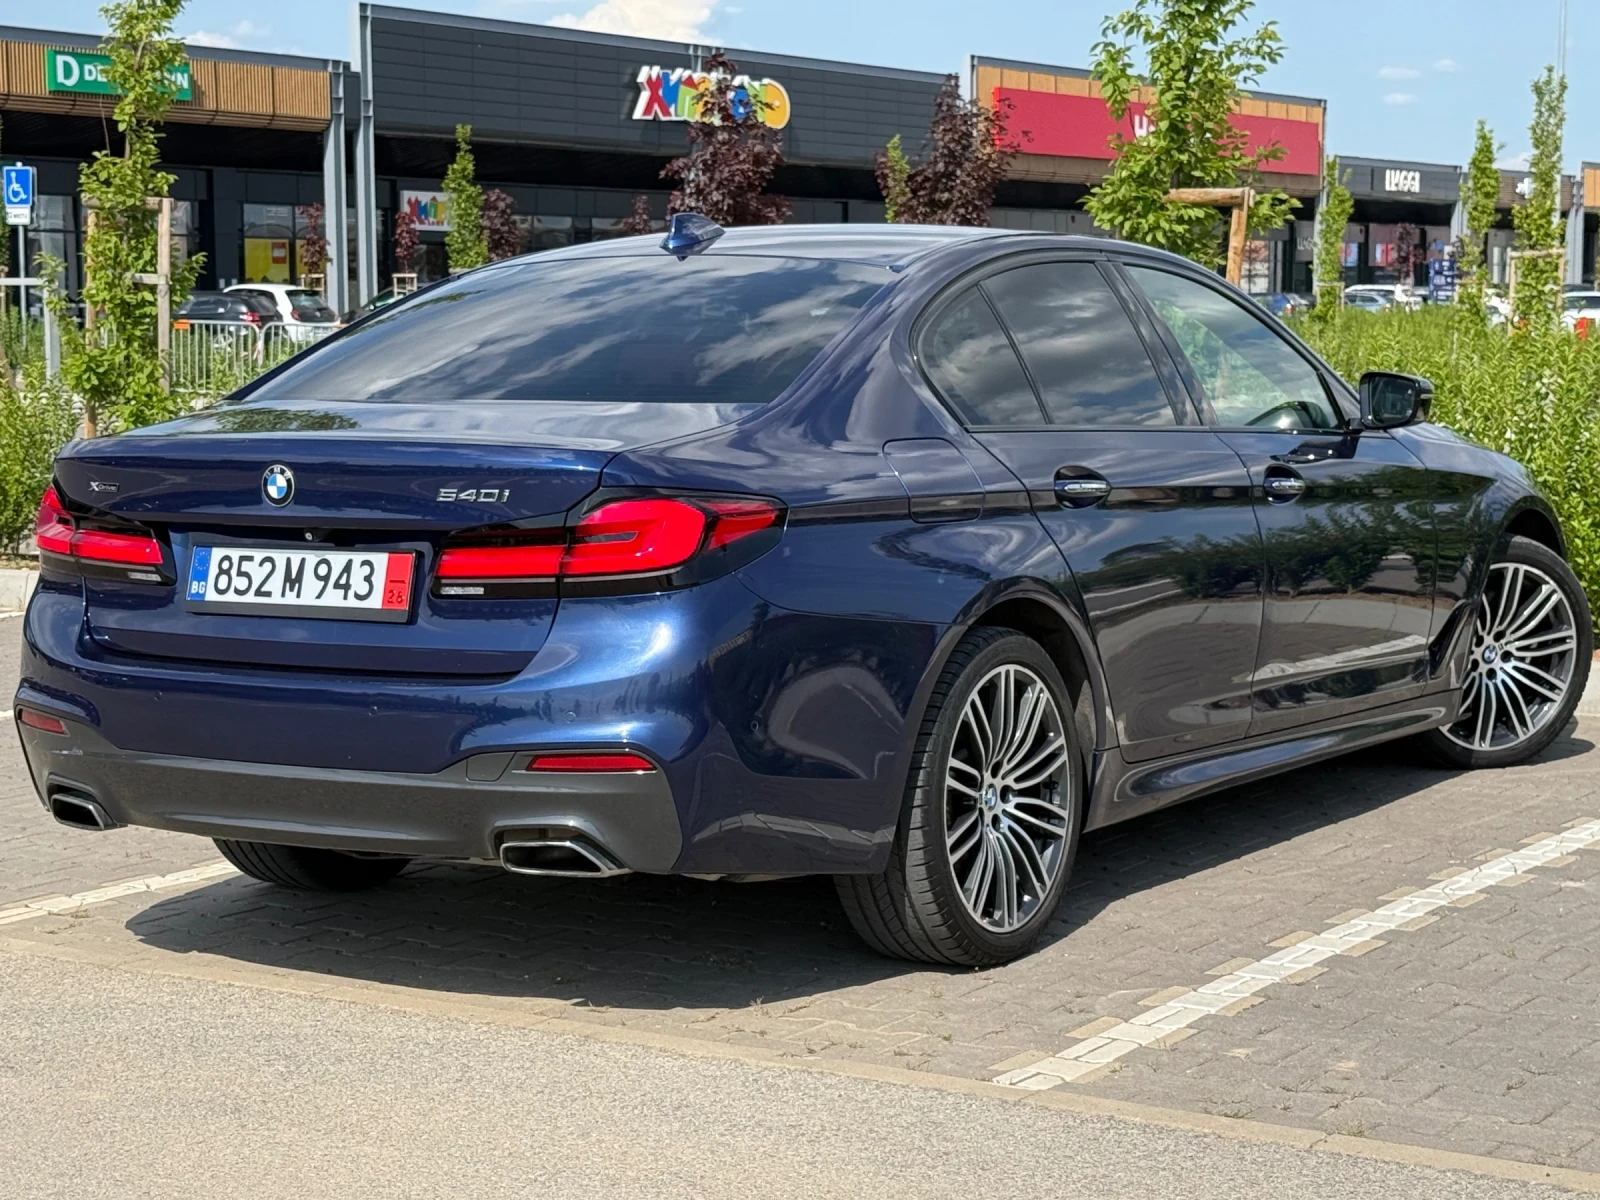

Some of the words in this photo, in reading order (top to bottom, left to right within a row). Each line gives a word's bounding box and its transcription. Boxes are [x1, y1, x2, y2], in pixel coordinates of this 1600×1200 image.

[436, 488, 510, 502] 540i
[213, 554, 277, 598] 852
[280, 556, 306, 599] M
[313, 558, 376, 601] 943
[190, 580, 207, 595] BG
